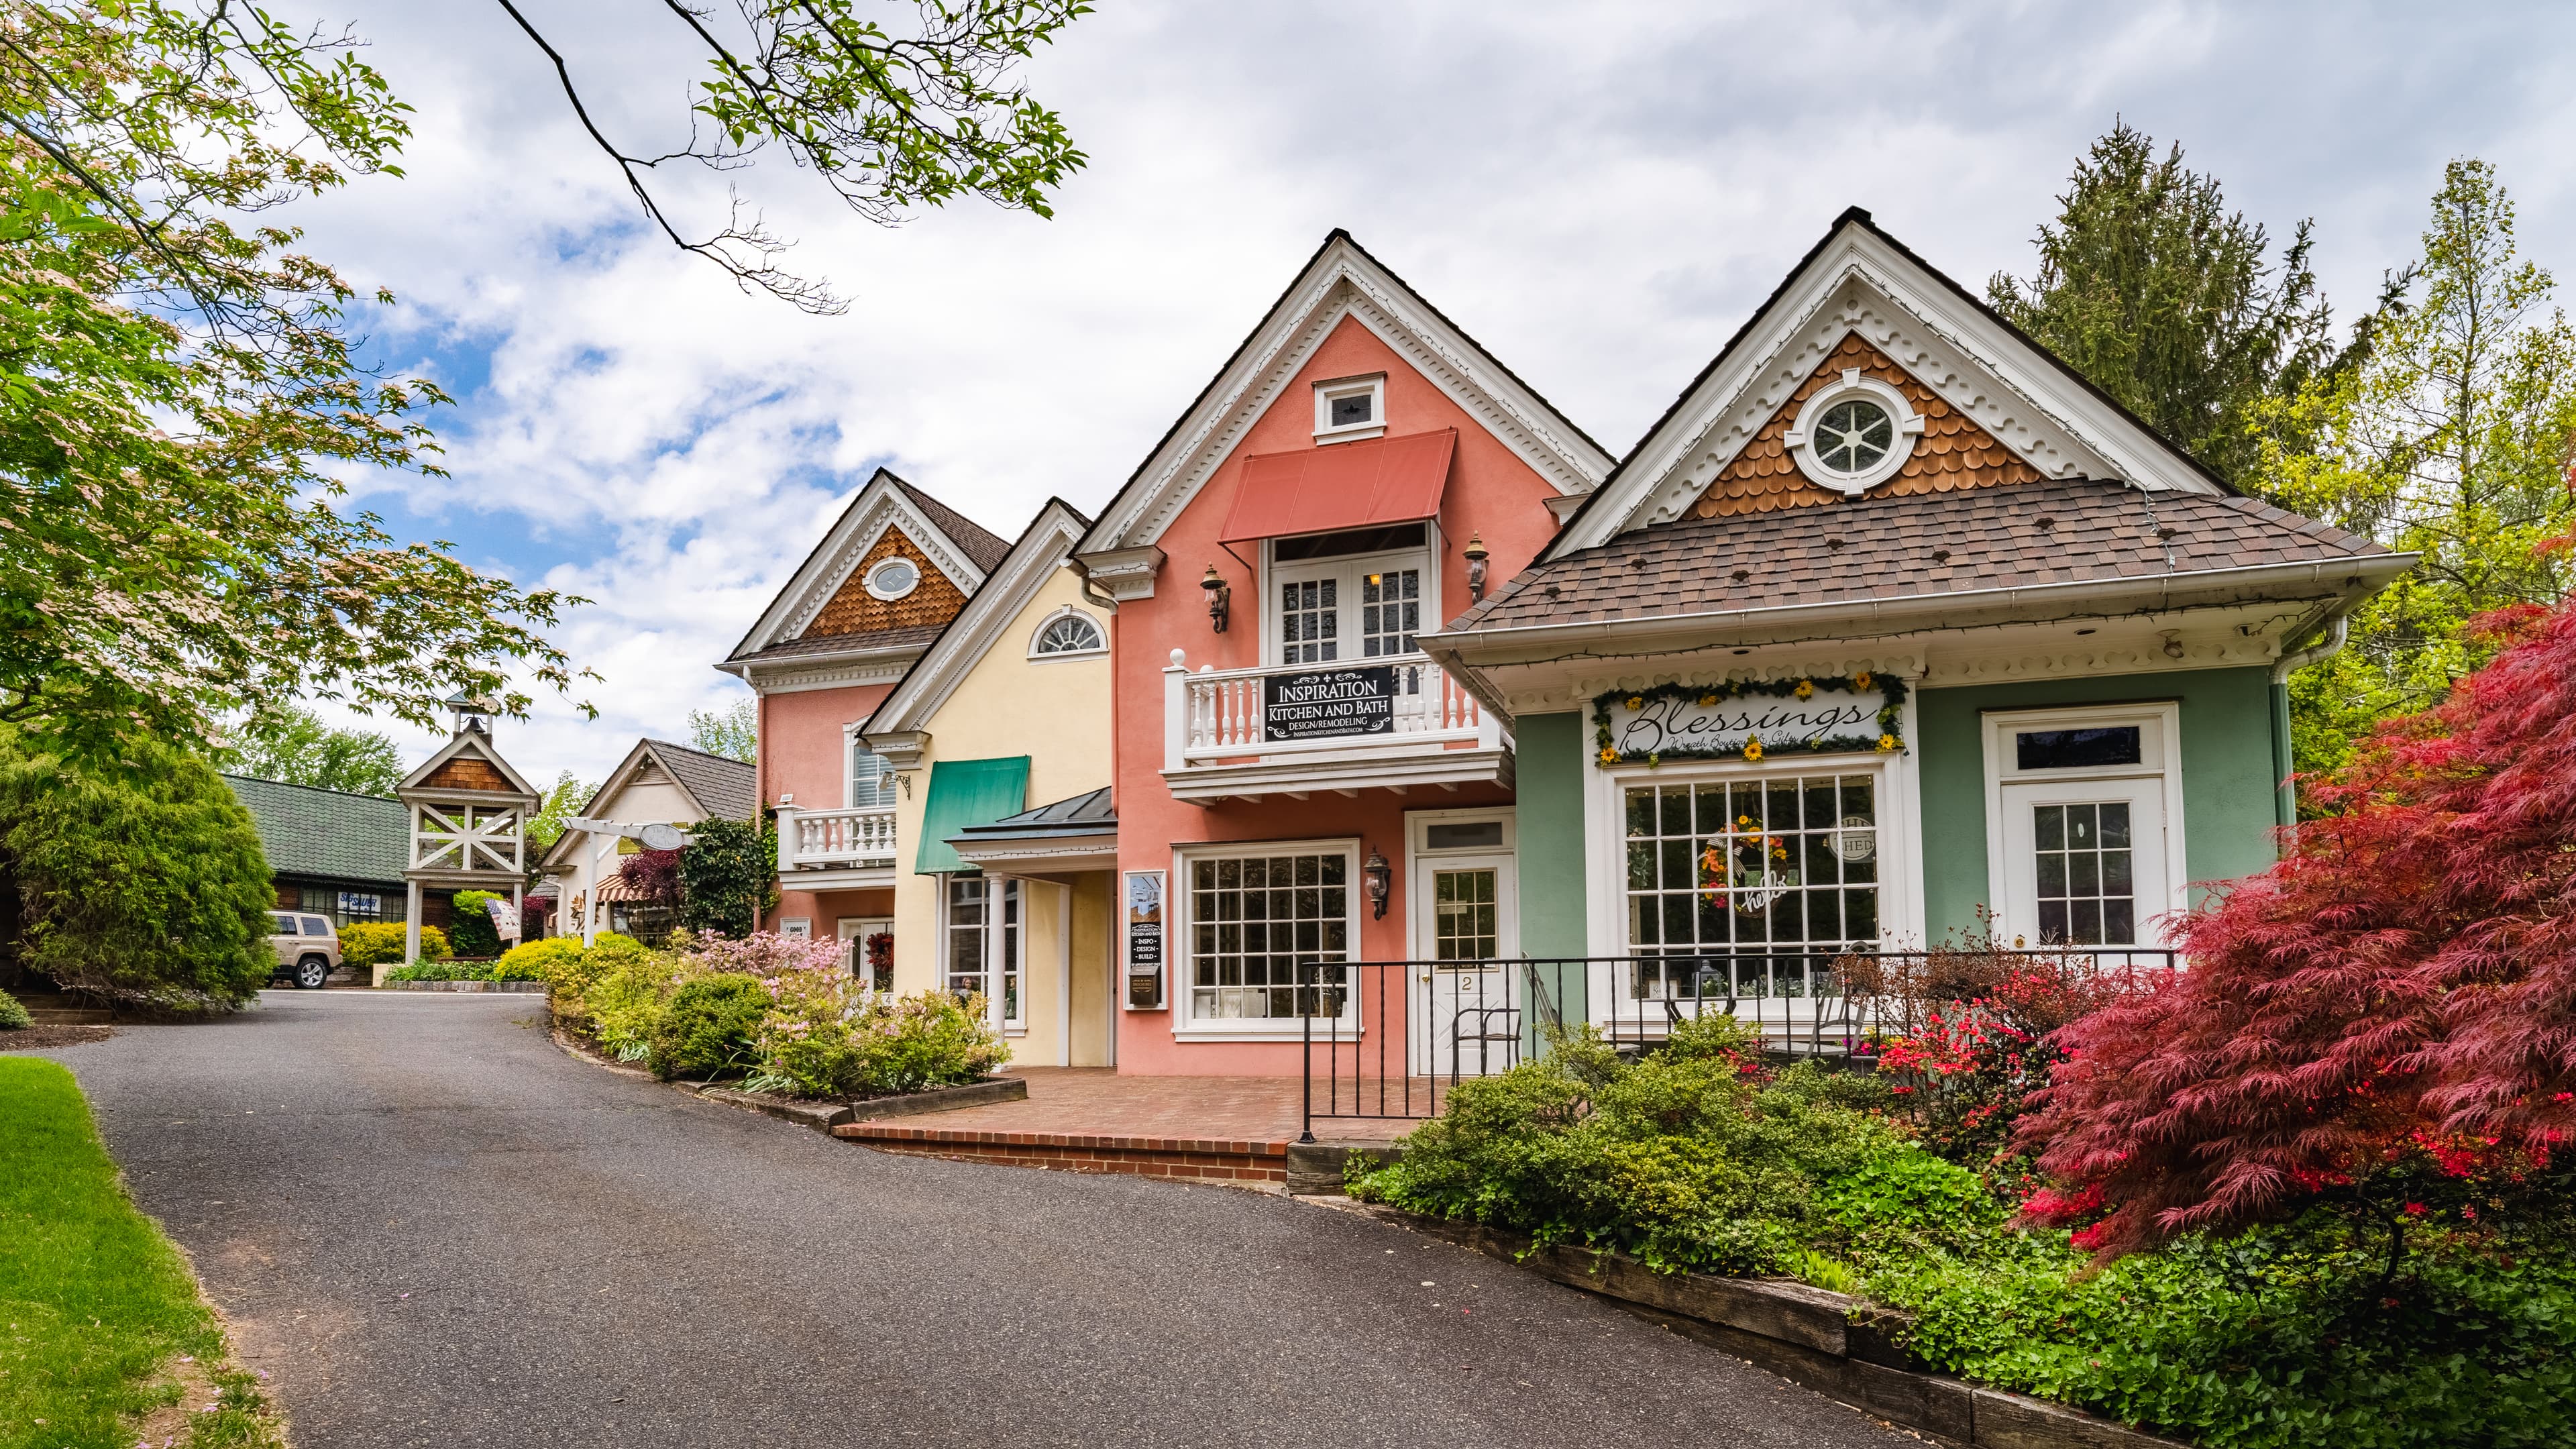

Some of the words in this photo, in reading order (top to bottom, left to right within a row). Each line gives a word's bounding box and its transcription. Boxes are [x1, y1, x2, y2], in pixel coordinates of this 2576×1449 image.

[1279, 680, 1377, 703] INSPIRATION
[1268, 705, 1322, 722] KITCHEN
[1324, 703, 1353, 717] AND
[1356, 700, 1388, 714] BATH
[1289, 716, 1368, 731] DESIGN/REMODELING
[1619, 700, 1878, 752] Blessings
[1709, 734, 1748, 750] Boutiqu
[1837, 840, 1872, 852] HED
[1462, 977, 1472, 990] 2
[885, 995, 891, 1004] 4
